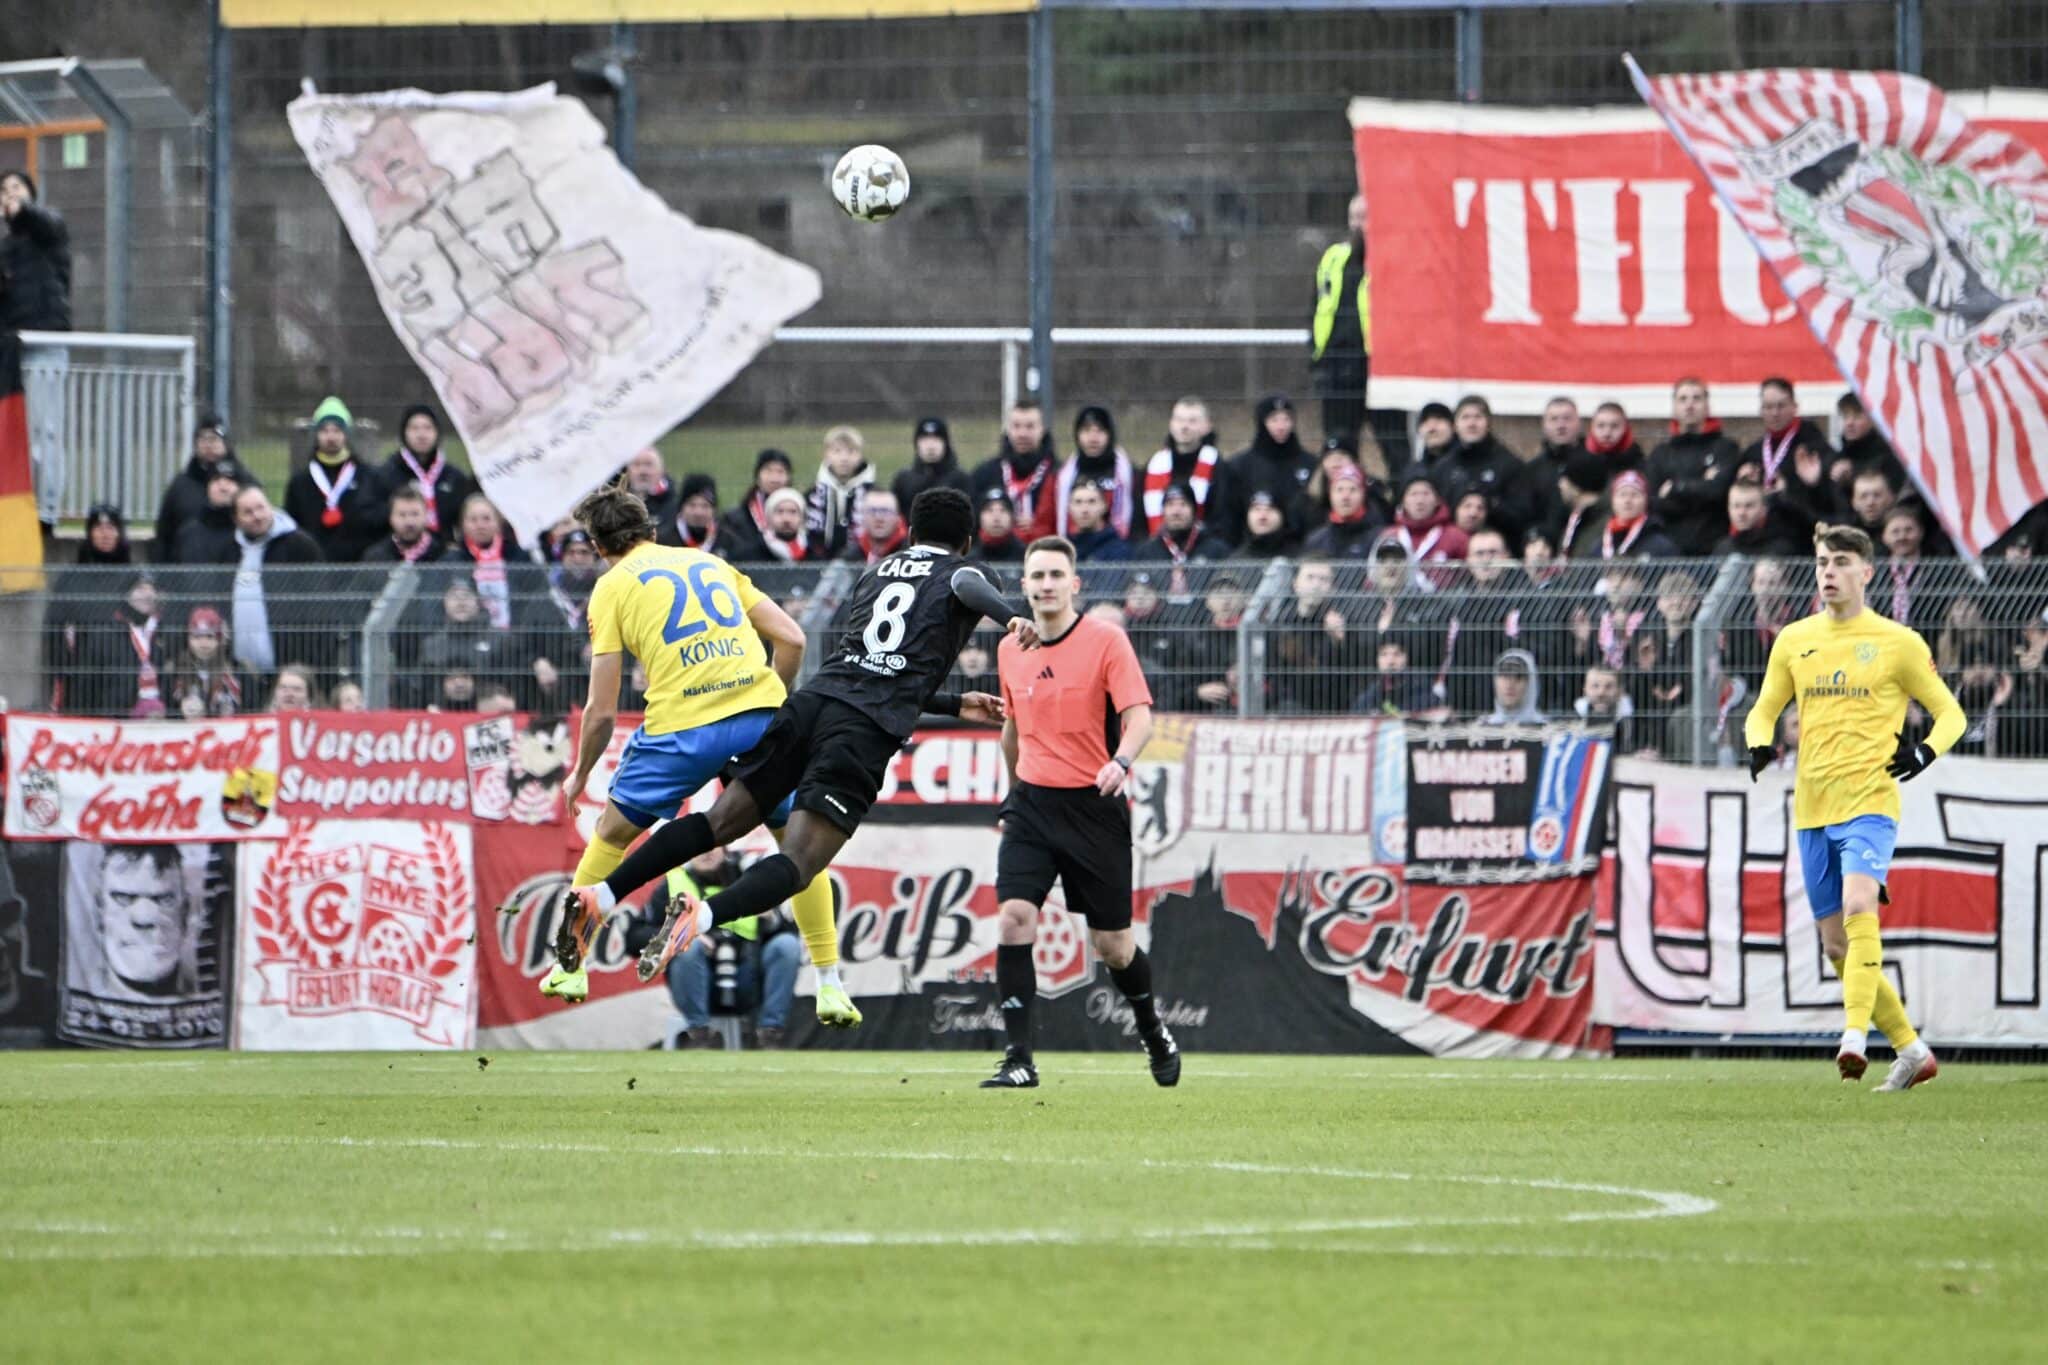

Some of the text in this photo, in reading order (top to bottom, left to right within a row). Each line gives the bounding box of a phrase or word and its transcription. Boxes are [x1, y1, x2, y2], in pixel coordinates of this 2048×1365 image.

[638, 562, 743, 646] 26
[863, 582, 915, 656] 8
[680, 637, 744, 667] KÖNIG
[683, 675, 755, 698] Märkischer Hof
[289, 719, 457, 767] Versatio
[278, 765, 469, 812] Supporters
[1191, 753, 1371, 834] BERLIN
[297, 852, 351, 880] HFC
[386, 854, 418, 882] FC
[368, 876, 428, 911] RWE
[829, 866, 974, 978] eiß
[1299, 867, 1592, 1005] Erfurt
